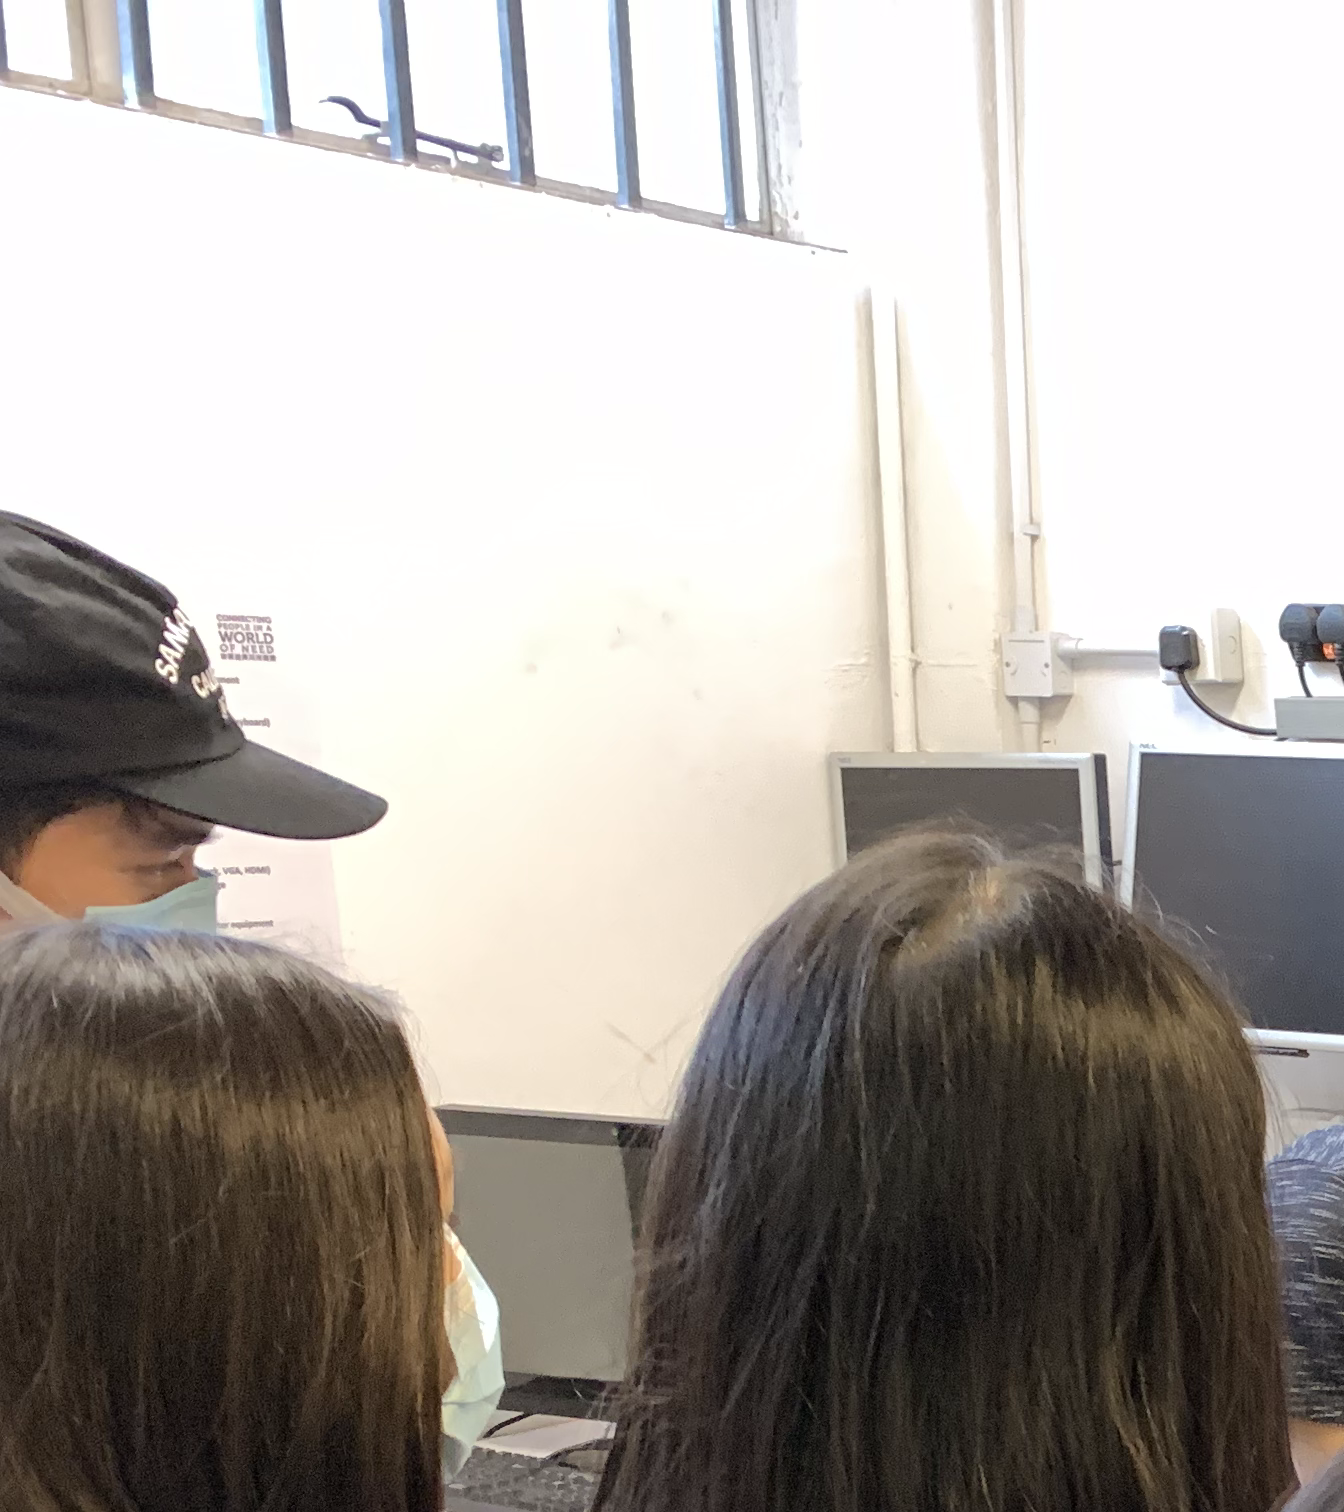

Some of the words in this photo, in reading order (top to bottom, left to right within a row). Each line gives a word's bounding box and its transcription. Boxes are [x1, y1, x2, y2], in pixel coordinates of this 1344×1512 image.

[218, 630, 274, 645] WORLD
[219, 643, 235, 653] OF
[241, 644, 275, 655] NEED
